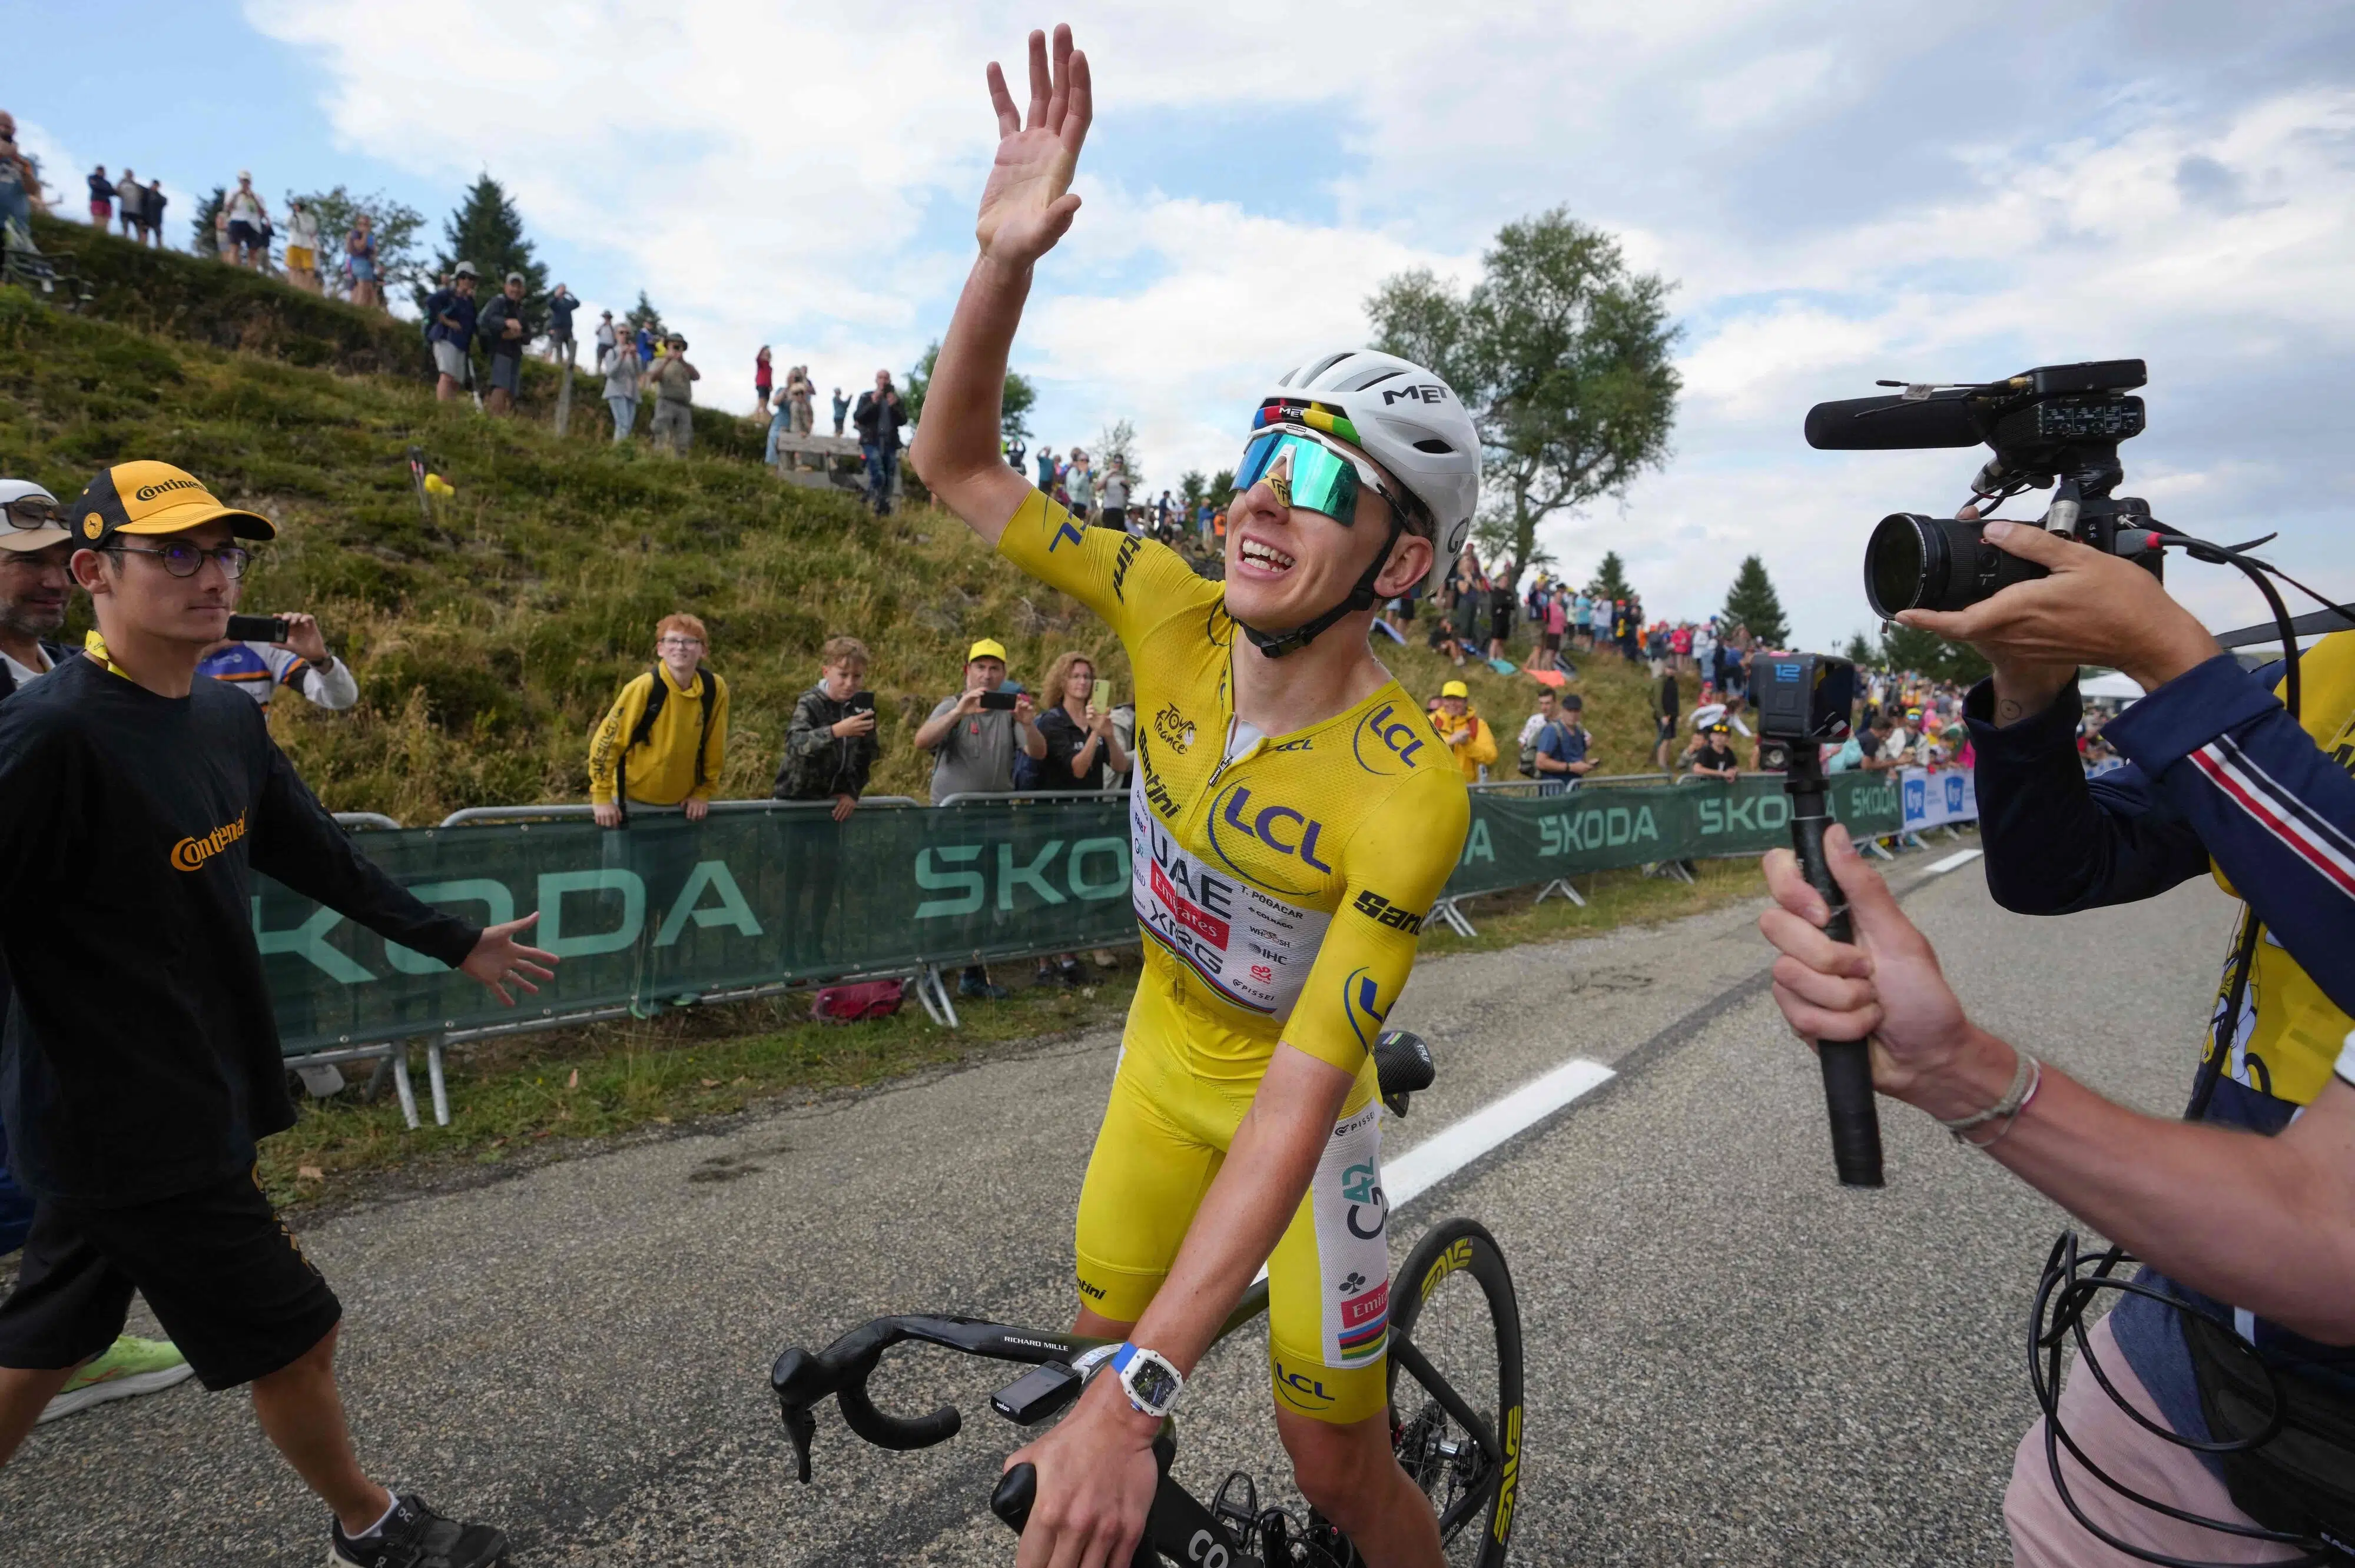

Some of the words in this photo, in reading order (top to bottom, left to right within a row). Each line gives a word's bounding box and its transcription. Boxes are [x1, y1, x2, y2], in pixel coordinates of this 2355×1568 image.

[1382, 384, 1451, 406] MET
[1279, 407, 1310, 418] MET
[1775, 663, 1801, 677] 12
[1275, 739, 1314, 752] LCL
[1369, 705, 1425, 768] LCL
[1224, 786, 1331, 875] LCL
[914, 836, 1133, 919] SKO
[1150, 816, 1234, 920] UAE
[1156, 871, 1218, 938] Emirates
[251, 859, 764, 984] KODA
[1256, 911, 1293, 929] COLNAGO
[1149, 898, 1224, 975] XRG
[1262, 948, 1288, 965] IHC
[1241, 985, 1275, 1001] PISSEI
[1351, 1111, 1375, 1131] PISSEI
[1342, 1155, 1385, 1240] G42
[1004, 1336, 1041, 1347] RICHARD
[1043, 1342, 1069, 1352] MILLE
[1276, 1361, 1336, 1401] LCL
[996, 1401, 1010, 1413] wahoo
[1441, 1520, 1460, 1546] irates
